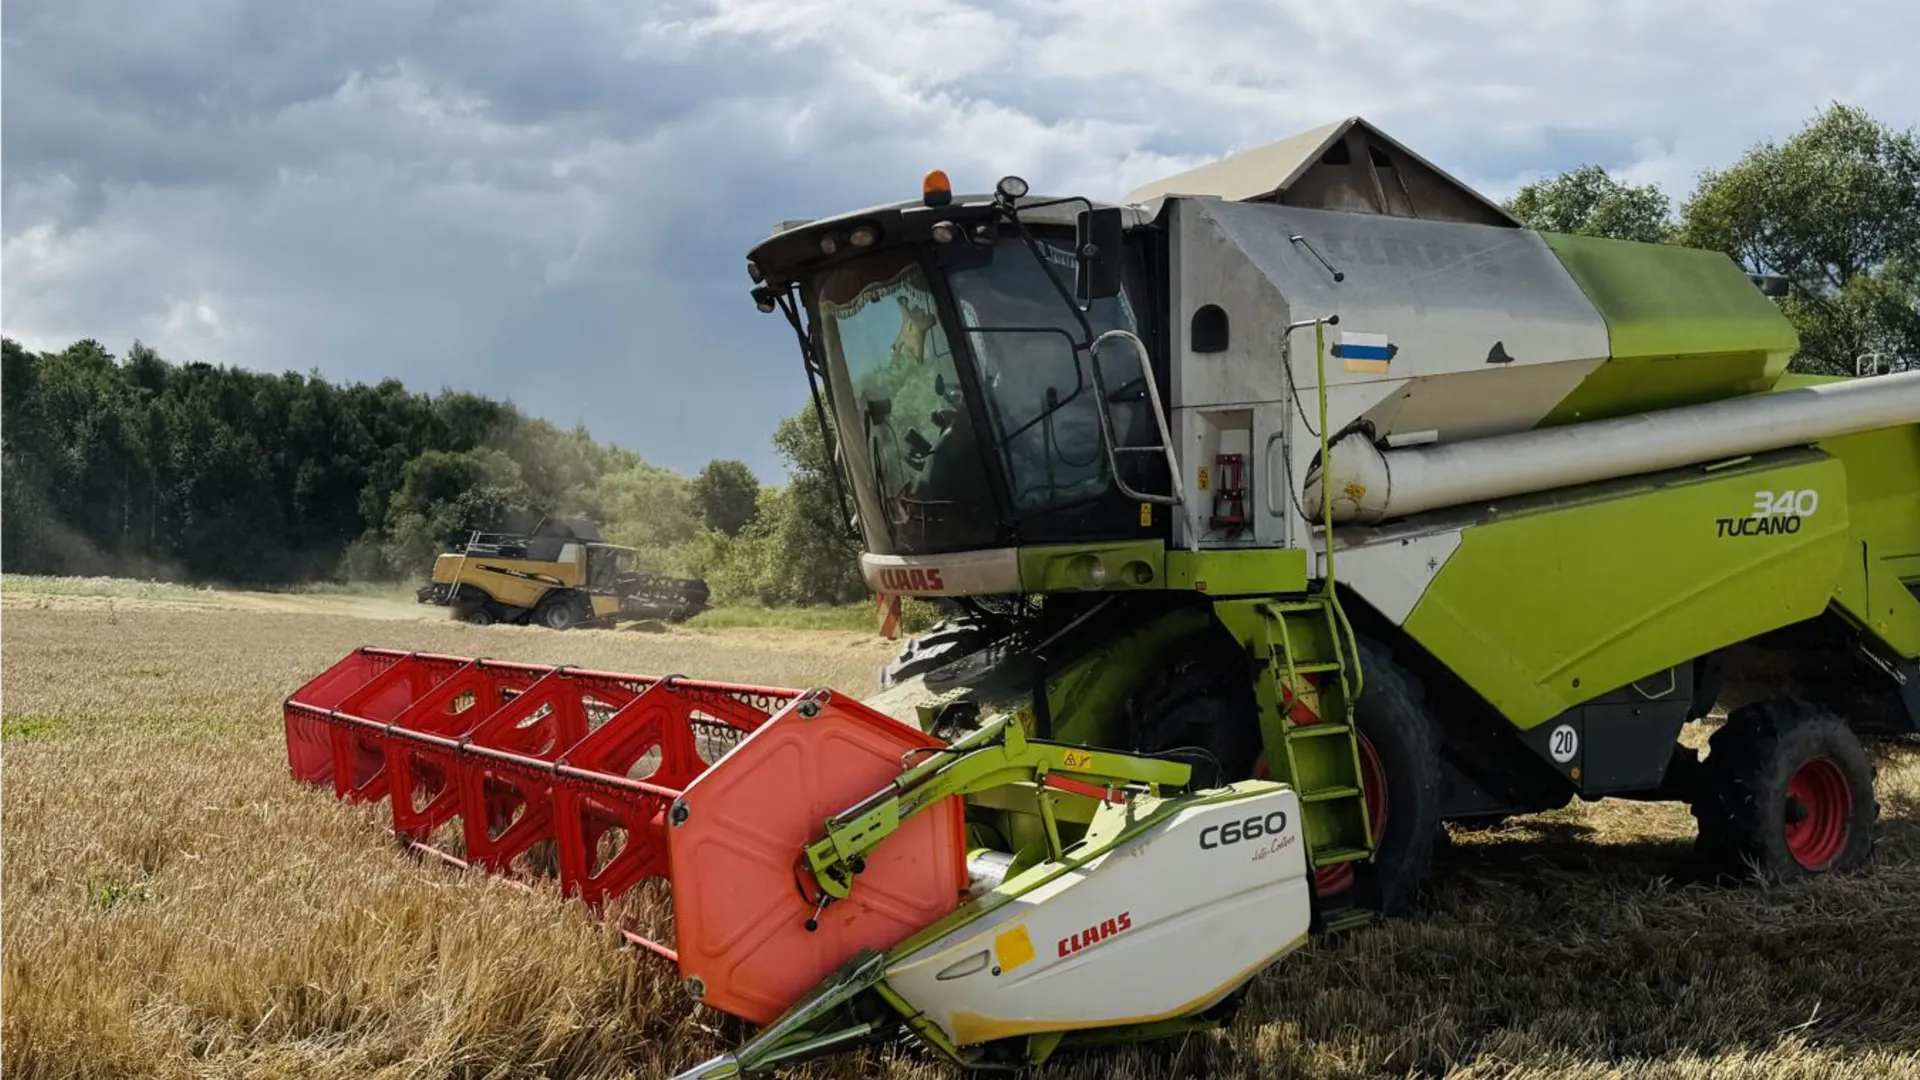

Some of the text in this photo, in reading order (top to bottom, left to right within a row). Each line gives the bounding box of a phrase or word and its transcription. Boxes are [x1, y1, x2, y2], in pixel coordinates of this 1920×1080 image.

[1752, 489, 1819, 519] 340
[1716, 515, 1801, 538] TUCANO
[879, 568, 945, 591] CLAAS
[1554, 730, 1573, 754] 20
[1199, 811, 1287, 850] C660
[1057, 911, 1132, 958] CLAAS
